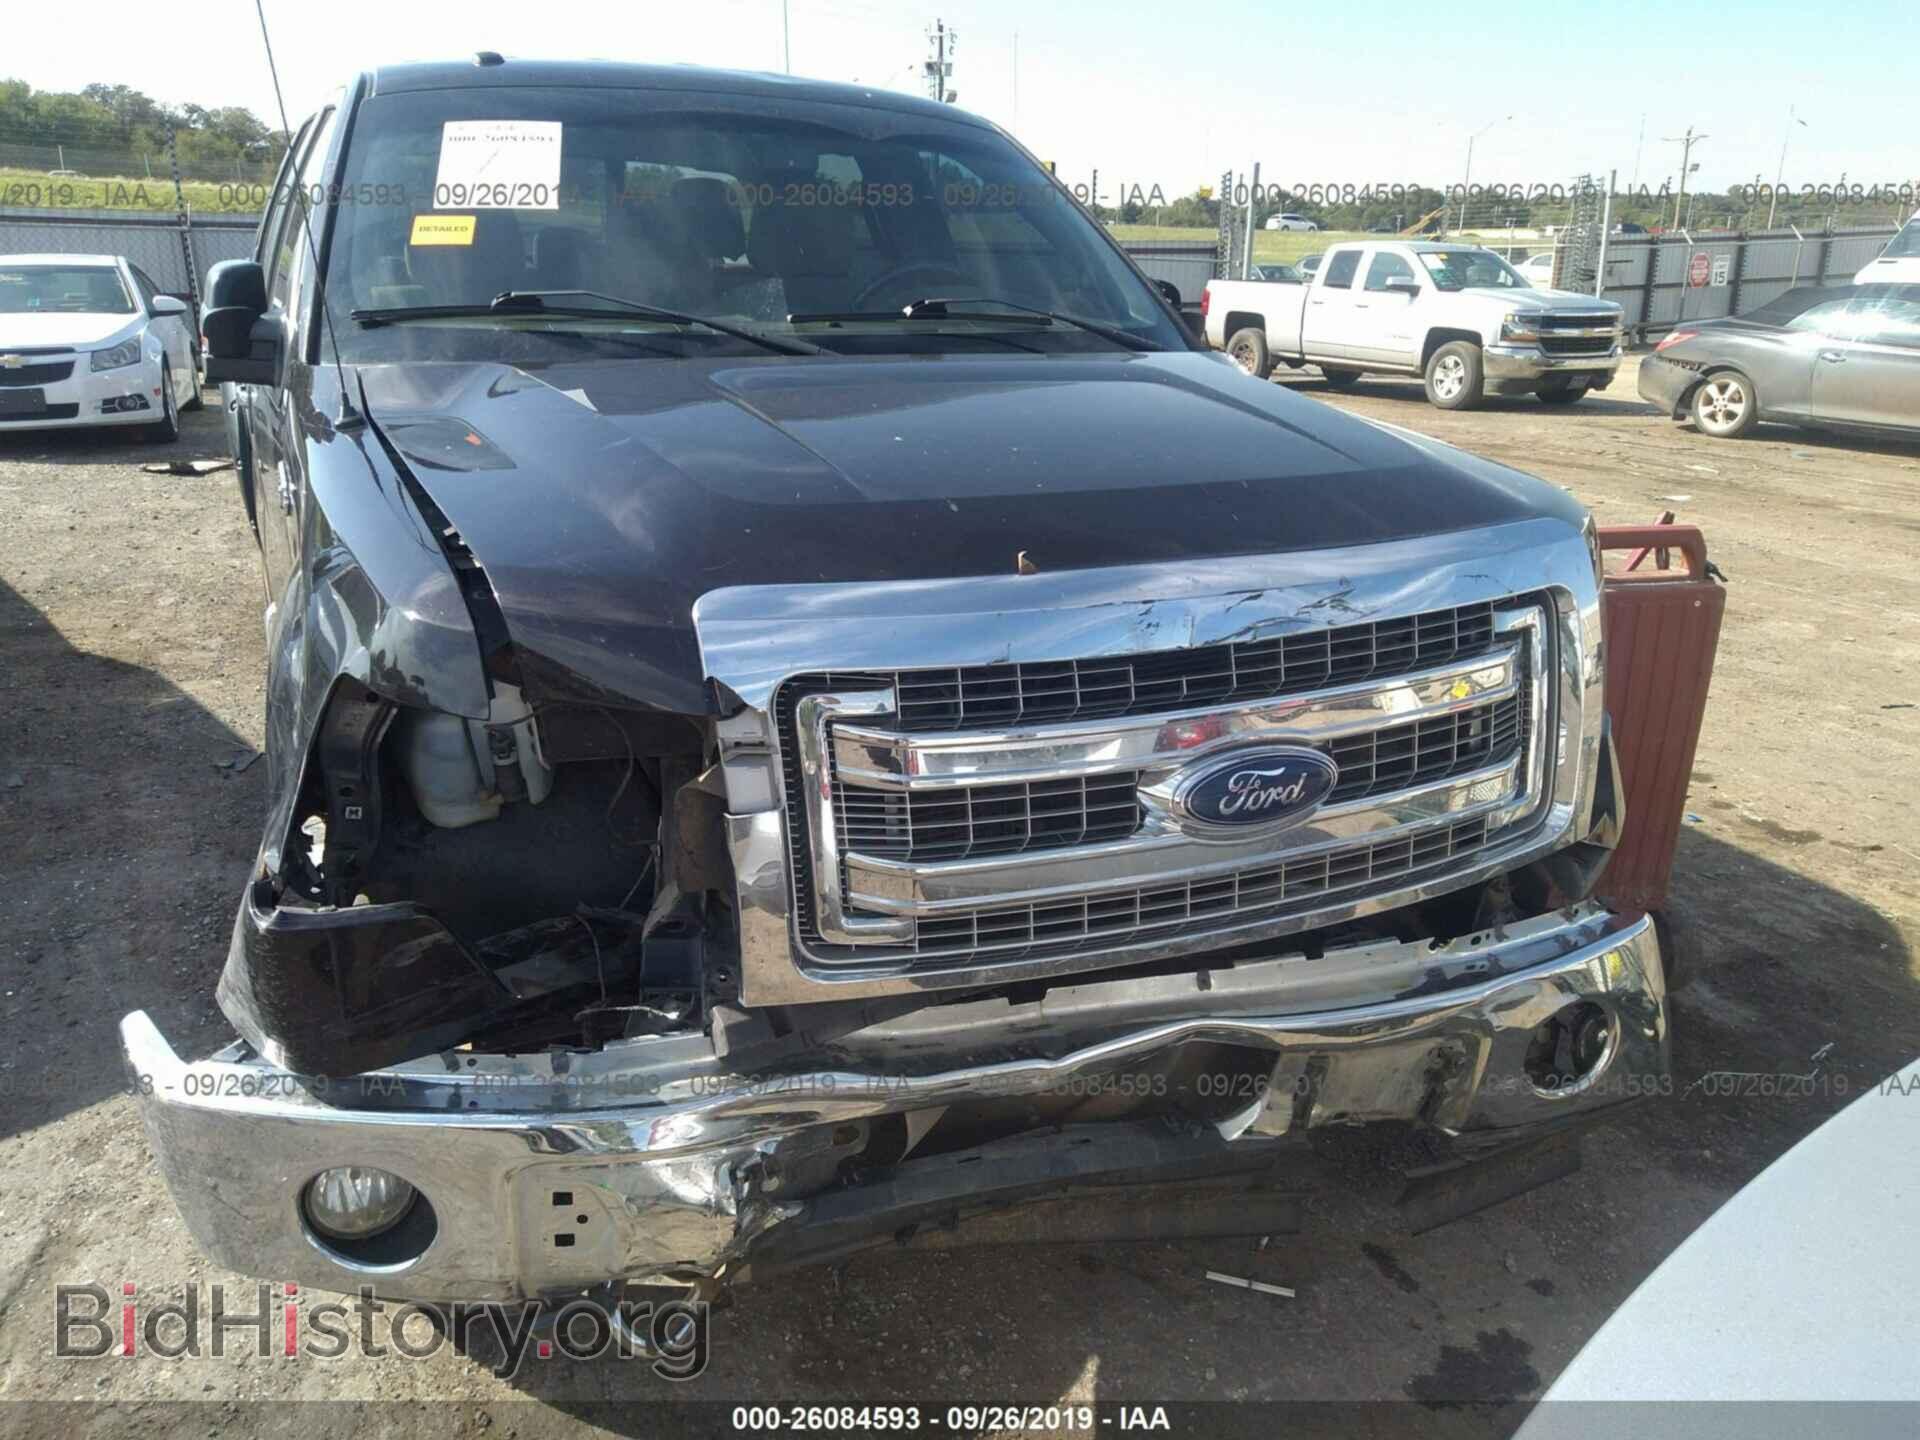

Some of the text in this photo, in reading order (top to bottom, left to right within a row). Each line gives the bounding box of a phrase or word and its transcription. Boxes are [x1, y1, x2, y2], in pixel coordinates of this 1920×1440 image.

[418, 225, 469, 233] DETAILED
[1714, 271, 1726, 285] 15
[1218, 766, 1309, 816] Ford
